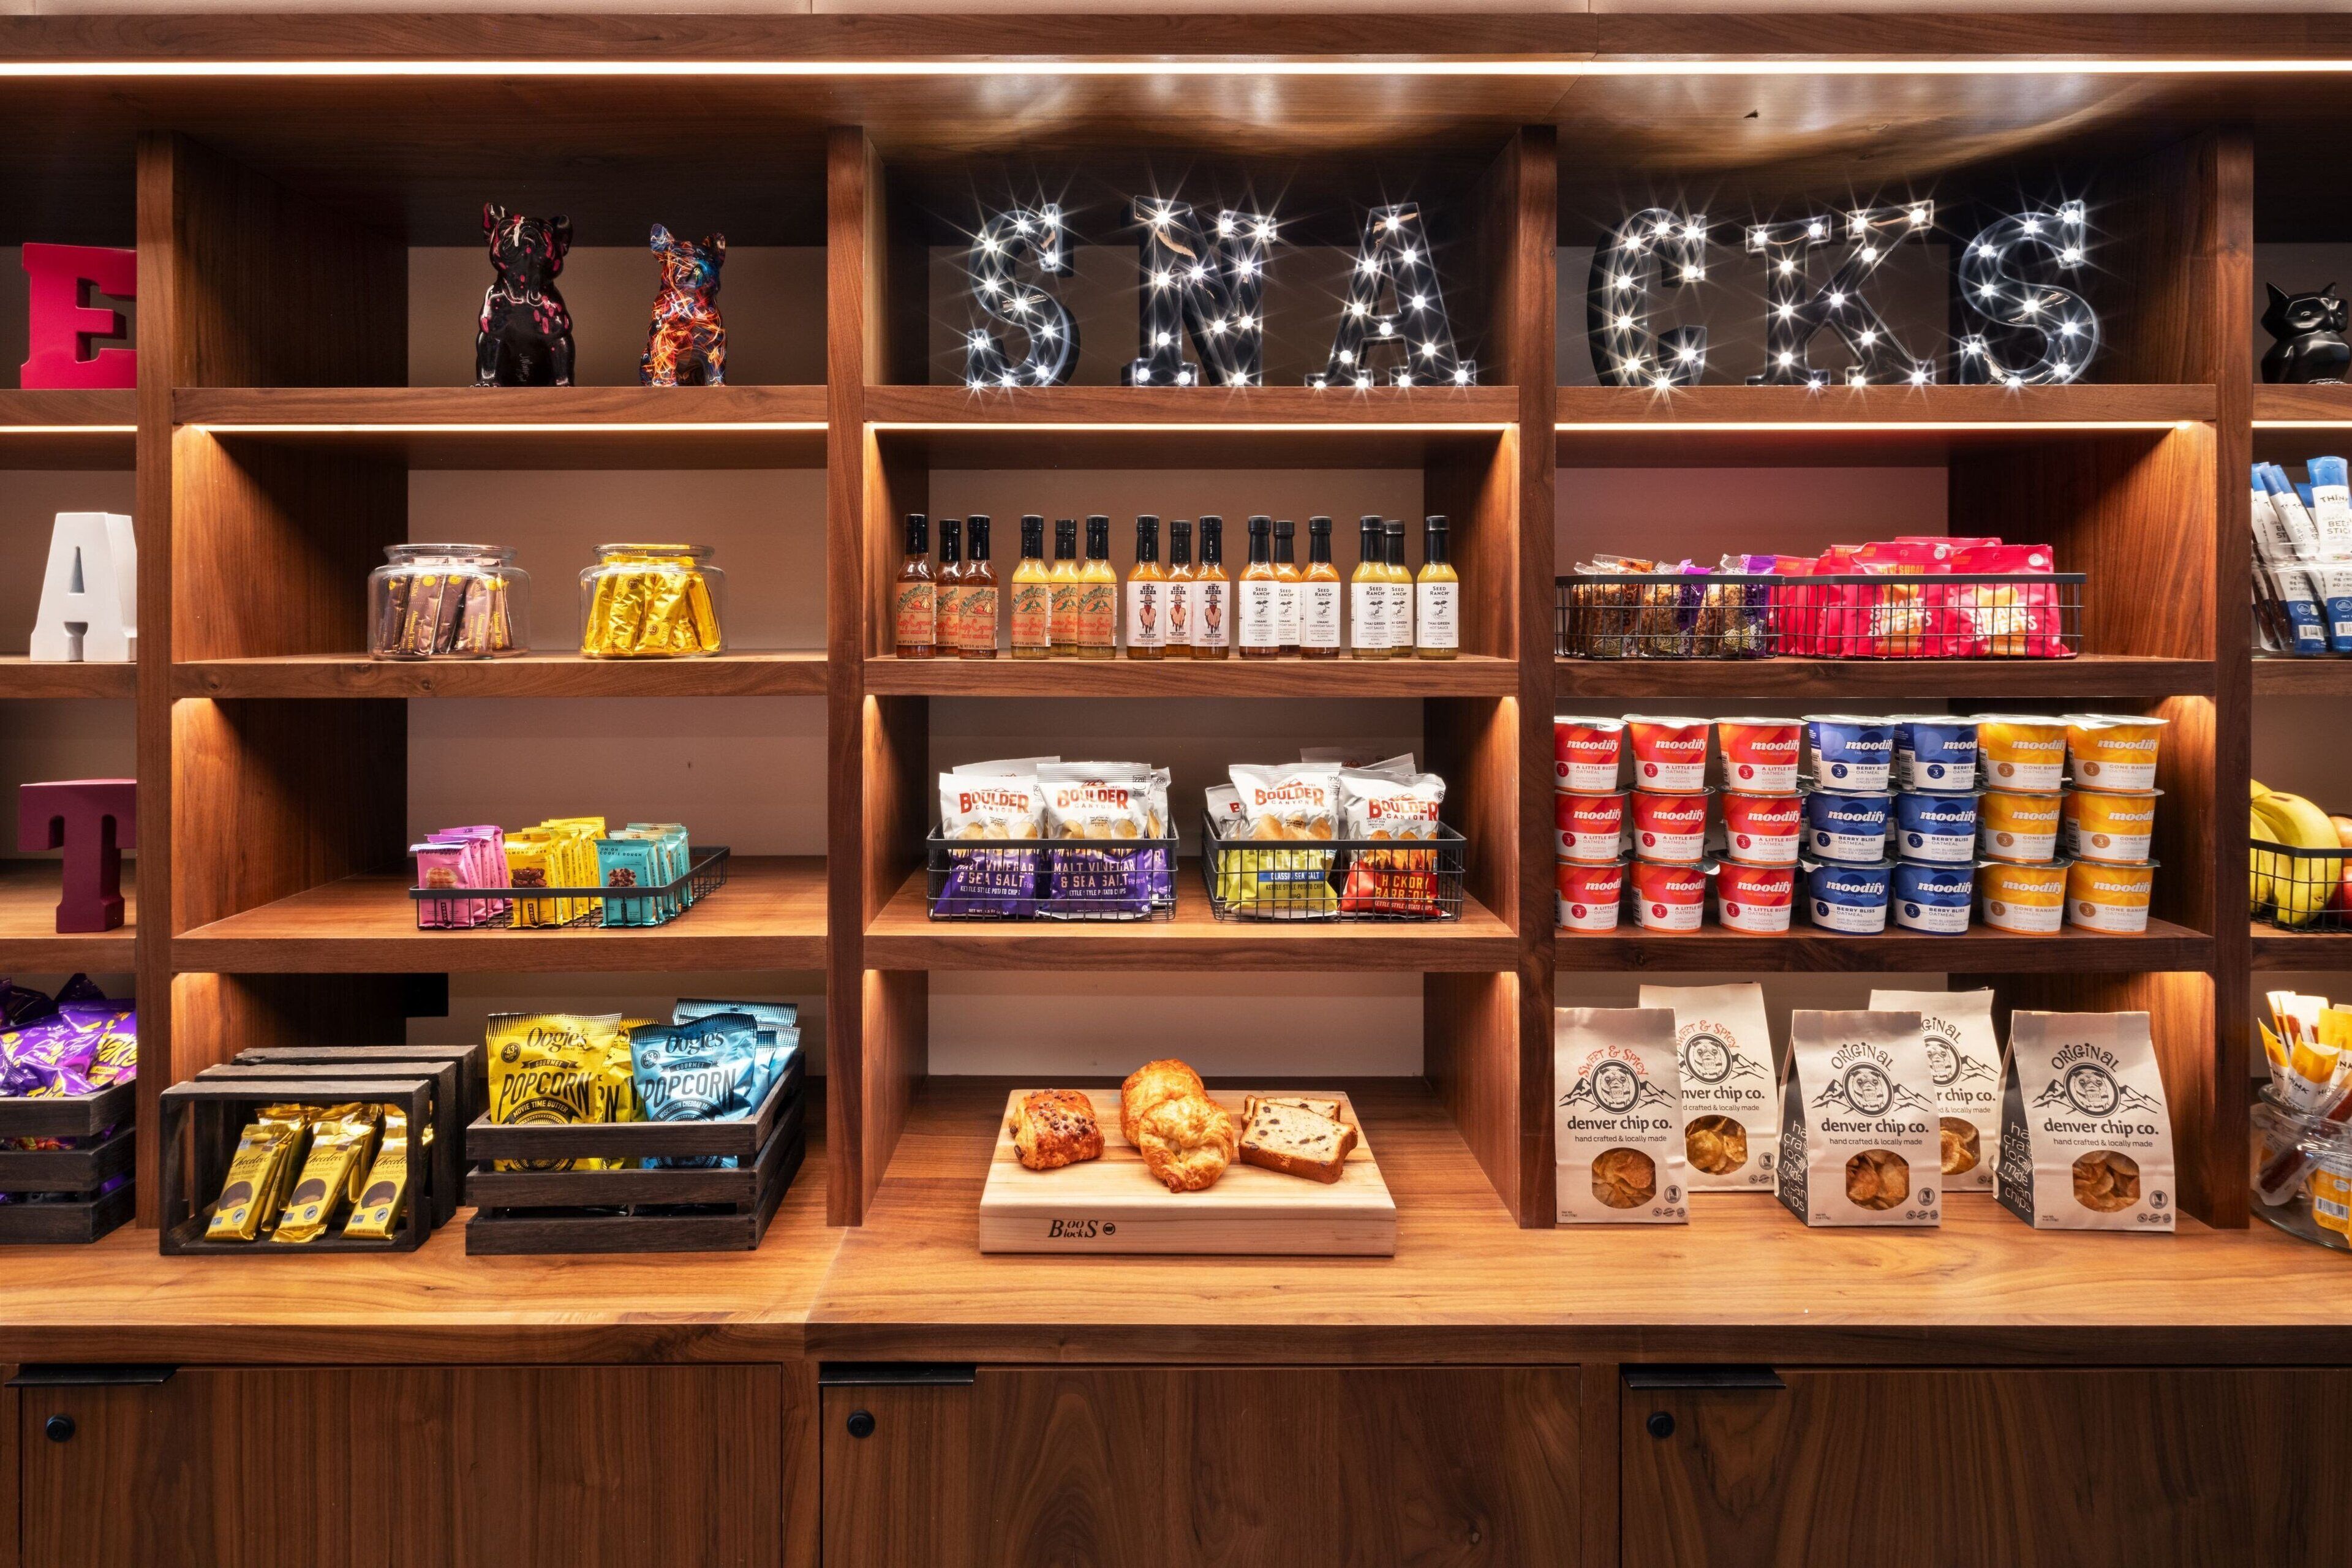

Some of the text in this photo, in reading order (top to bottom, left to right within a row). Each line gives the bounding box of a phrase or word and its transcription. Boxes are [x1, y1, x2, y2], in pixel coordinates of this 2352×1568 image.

[1566, 739, 1619, 752] moodify
[1655, 739, 1706, 752] moodify
[1942, 738, 1978, 750] mood
[2097, 739, 2157, 753] moodify
[959, 791, 1029, 814] BOULDER
[1057, 789, 1128, 810] BOULDER
[1255, 786, 1325, 807] BOULDER
[1369, 797, 1439, 821] BOULDER
[1573, 808, 1621, 821] moodify
[1653, 809, 1705, 821] moodify
[1747, 810, 1800, 823] moodify
[1827, 809, 1885, 824] moodify
[1920, 809, 1976, 823] moodify
[986, 860, 1035, 876] VINEGAR
[1054, 859, 1135, 875] MALT VINEGAR
[969, 872, 990, 885] SEA
[996, 873, 1025, 888] SALT
[1061, 876, 1068, 888] &
[1073, 875, 1096, 888] SEA
[1102, 873, 1128, 887] SALT
[1295, 872, 1305, 880] SEA
[1736, 880, 1792, 894] moodify
[1825, 880, 1885, 895] moodify
[1917, 881, 1972, 894] moodify
[2002, 880, 2062, 894] moodify
[2092, 881, 2151, 894] moodify
[1699, 1019, 1711, 1032] &
[527, 1027, 589, 1053] Oogie's
[1608, 1045, 1621, 1058] &
[676, 1062, 704, 1071] GOURMET
[497, 1072, 592, 1122] POPCORN
[644, 1068, 736, 1111] POPCORN
[1681, 1086, 1765, 1102] nver chip co.
[1945, 1088, 1996, 1104] chip co.
[513, 1103, 531, 1118] MOVIE
[547, 1101, 569, 1113] BUTTER
[658, 1099, 701, 1119] WISCONSIN CHEDDAR
[1567, 1115, 1673, 1133] denver chip co.
[1821, 1117, 1929, 1136] denver chip co.
[2044, 1117, 2159, 1138] denver chip co.
[1624, 1135, 1646, 1144] locally
[1880, 1137, 1902, 1147] locally
[2108, 1139, 2131, 1148] locally
